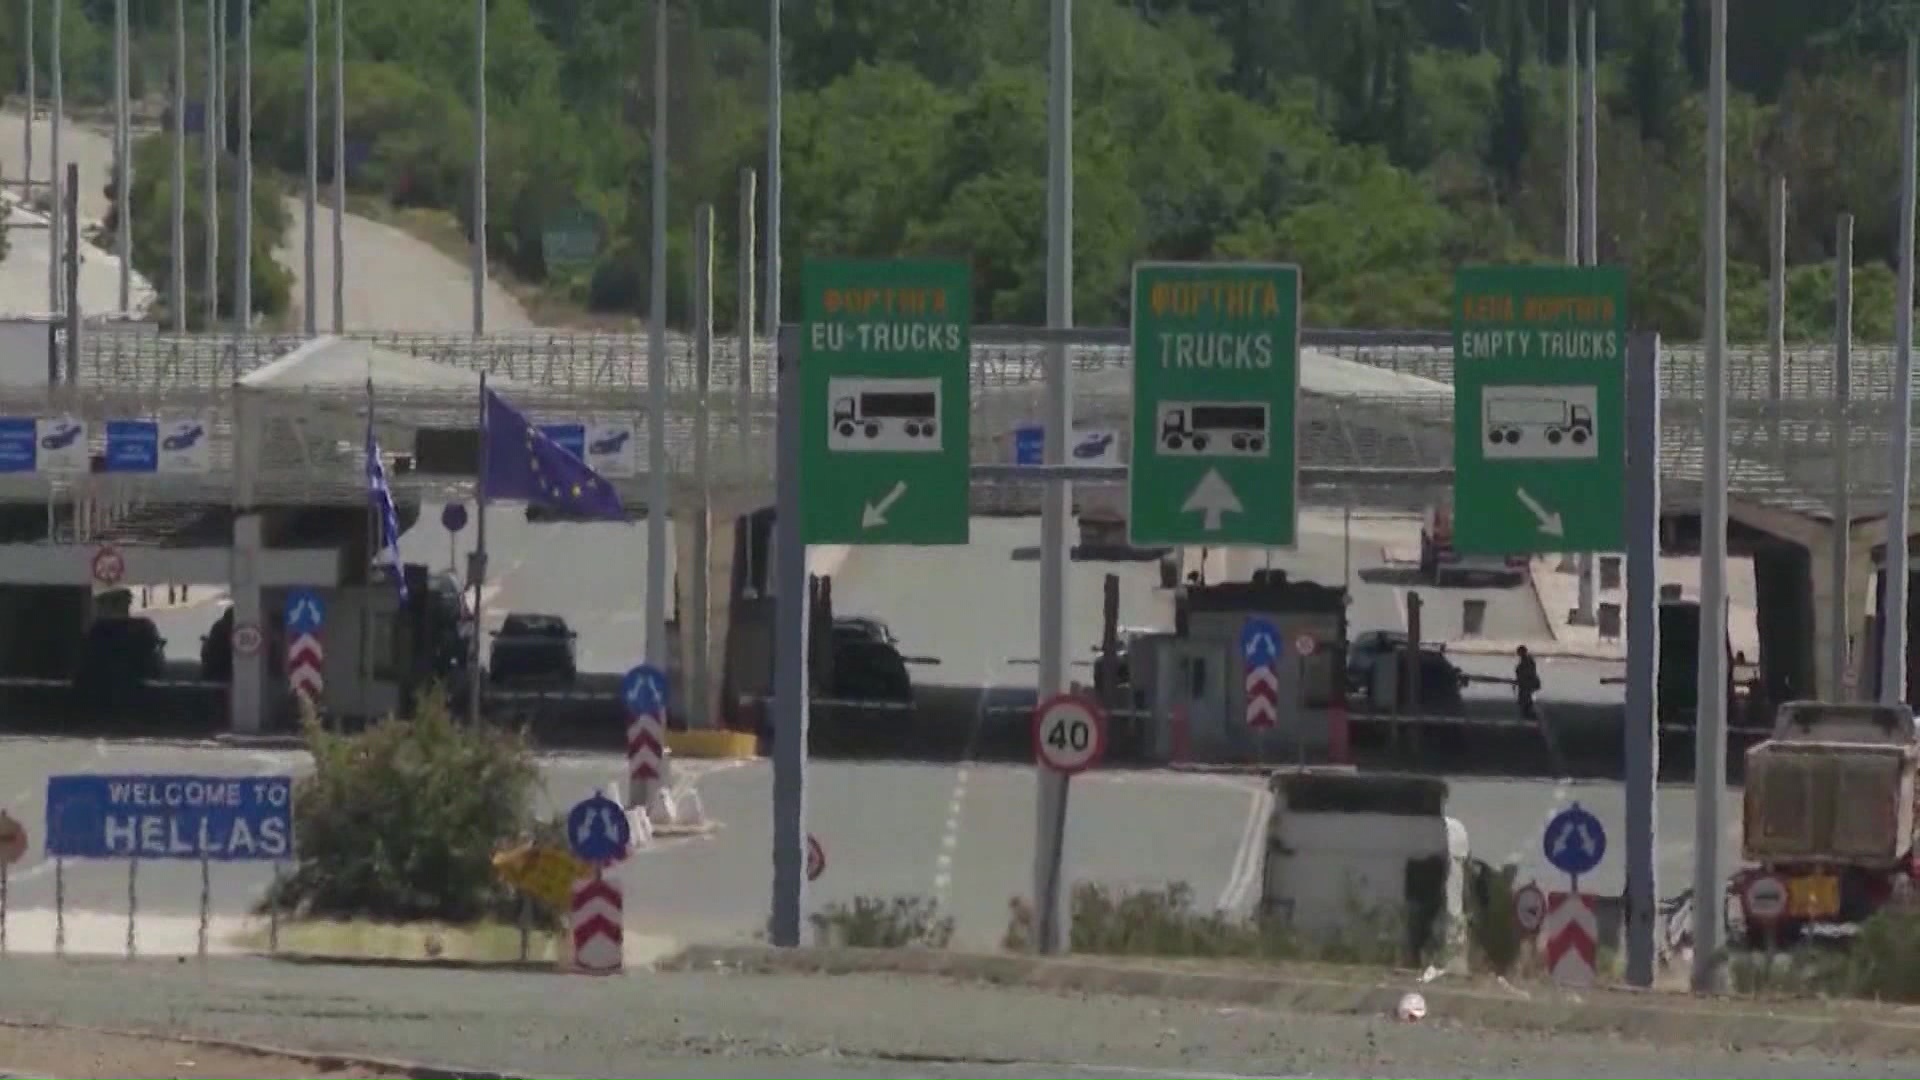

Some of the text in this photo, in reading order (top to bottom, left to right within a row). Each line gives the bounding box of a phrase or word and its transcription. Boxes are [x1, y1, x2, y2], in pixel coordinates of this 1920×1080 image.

[1159, 331, 1273, 369] TRUCKS
[1462, 329, 1617, 358] EMPTY TRUCKS
[1047, 719, 1089, 752] 40
[109, 782, 288, 807] WELCOME TO
[104, 814, 288, 855] HELLAS
